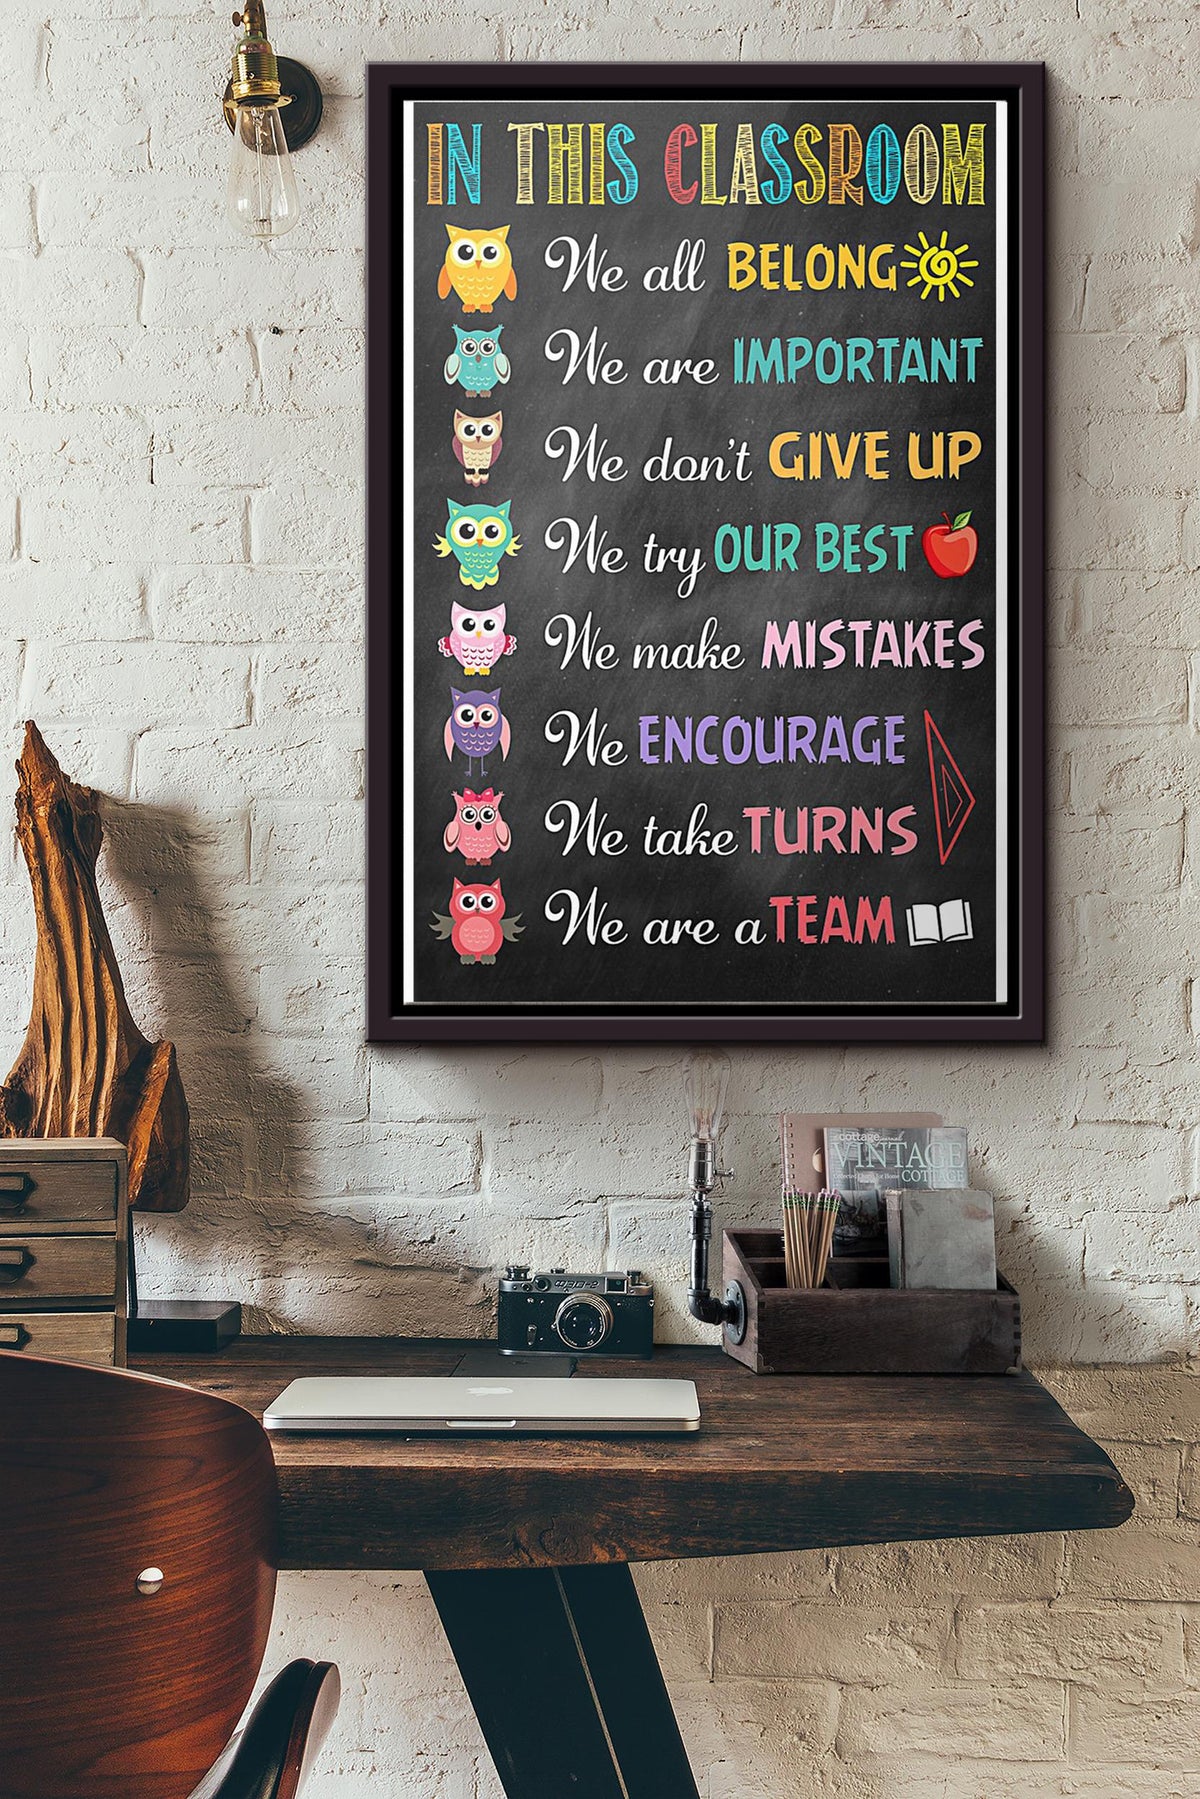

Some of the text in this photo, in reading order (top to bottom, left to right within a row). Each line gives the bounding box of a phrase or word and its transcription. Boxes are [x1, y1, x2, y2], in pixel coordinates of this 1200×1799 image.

[426, 122, 987, 206] IN THIS CLASSROOM
[544, 233, 897, 293] We all BELONG
[544, 325, 984, 385] We are IMPORTANT
[544, 422, 982, 483] We don't GIVE UP
[544, 514, 914, 599] We try OUR BEST
[544, 610, 985, 670] We make MISTAKES
[544, 707, 906, 767] We ENCOURAGE
[544, 797, 918, 857] We take TURNS
[544, 886, 896, 946] We are a TEAM
[832, 1141, 965, 1168] VINTAGE
[839, 1131, 880, 1143] cottage
[901, 1169, 965, 1182] COTTAGE
